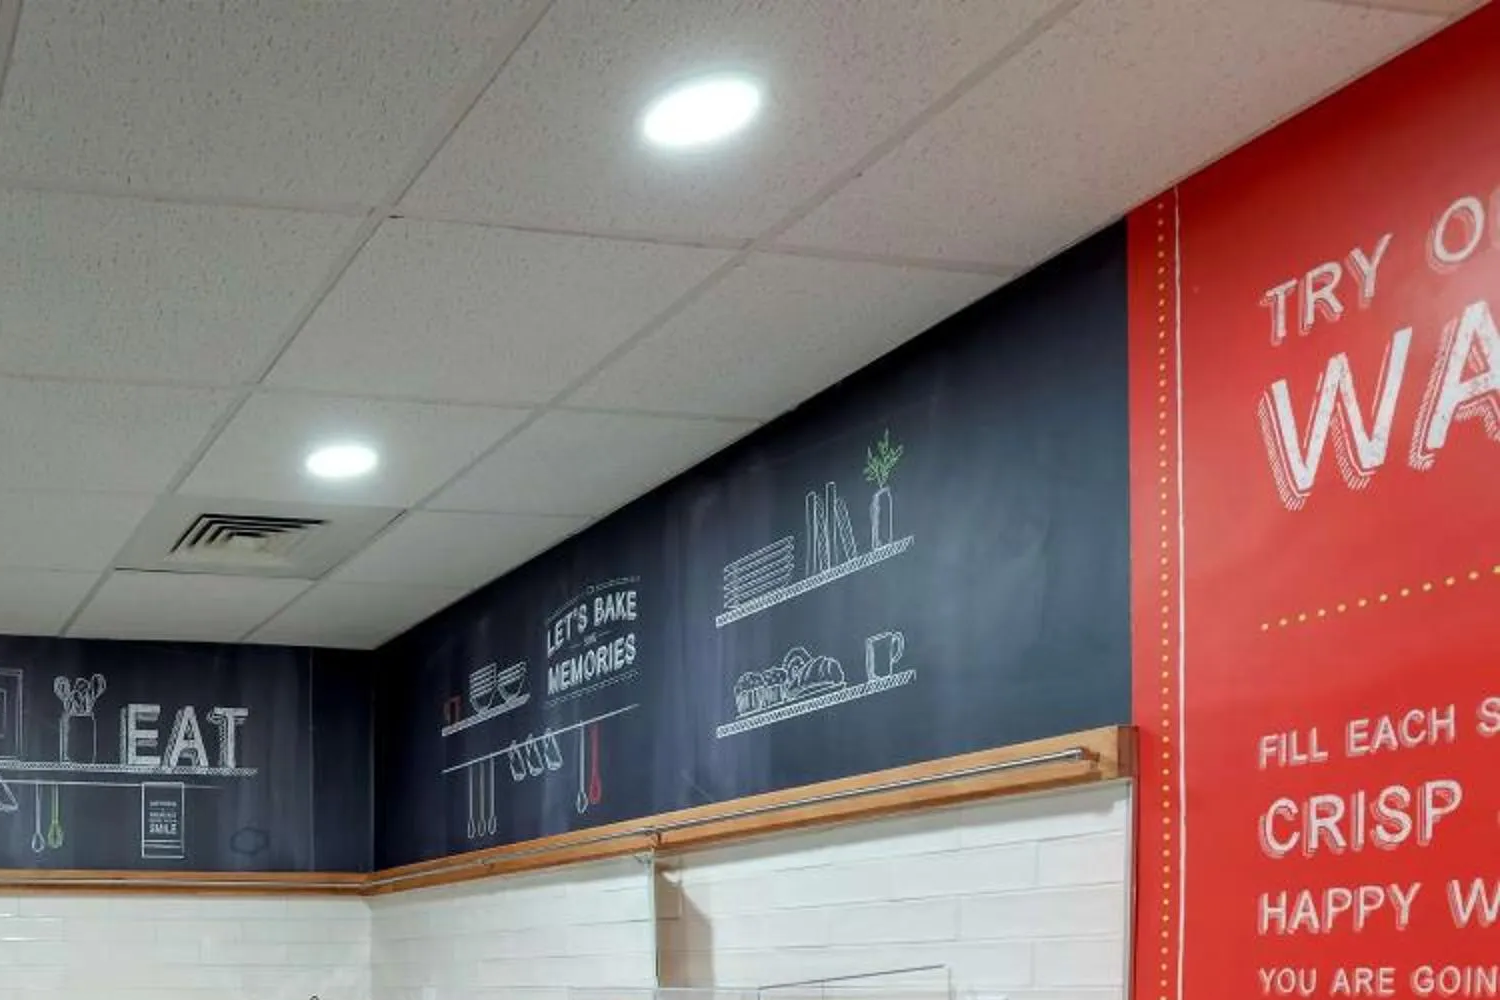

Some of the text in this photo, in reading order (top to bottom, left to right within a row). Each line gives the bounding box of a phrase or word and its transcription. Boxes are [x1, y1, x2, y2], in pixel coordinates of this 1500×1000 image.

[1260, 184, 1500, 344] TRY O
[547, 590, 638, 658] LET'S BAKE
[547, 632, 637, 696] MEMORIES
[120, 703, 249, 770] EAT
[1258, 726, 1329, 770] FILL
[1345, 703, 1456, 758] EACH
[1258, 779, 1462, 858] CRISP
[1258, 882, 1421, 935] HAPPY
[1259, 966, 1318, 997] YOU
[1330, 966, 1396, 997] ARE
